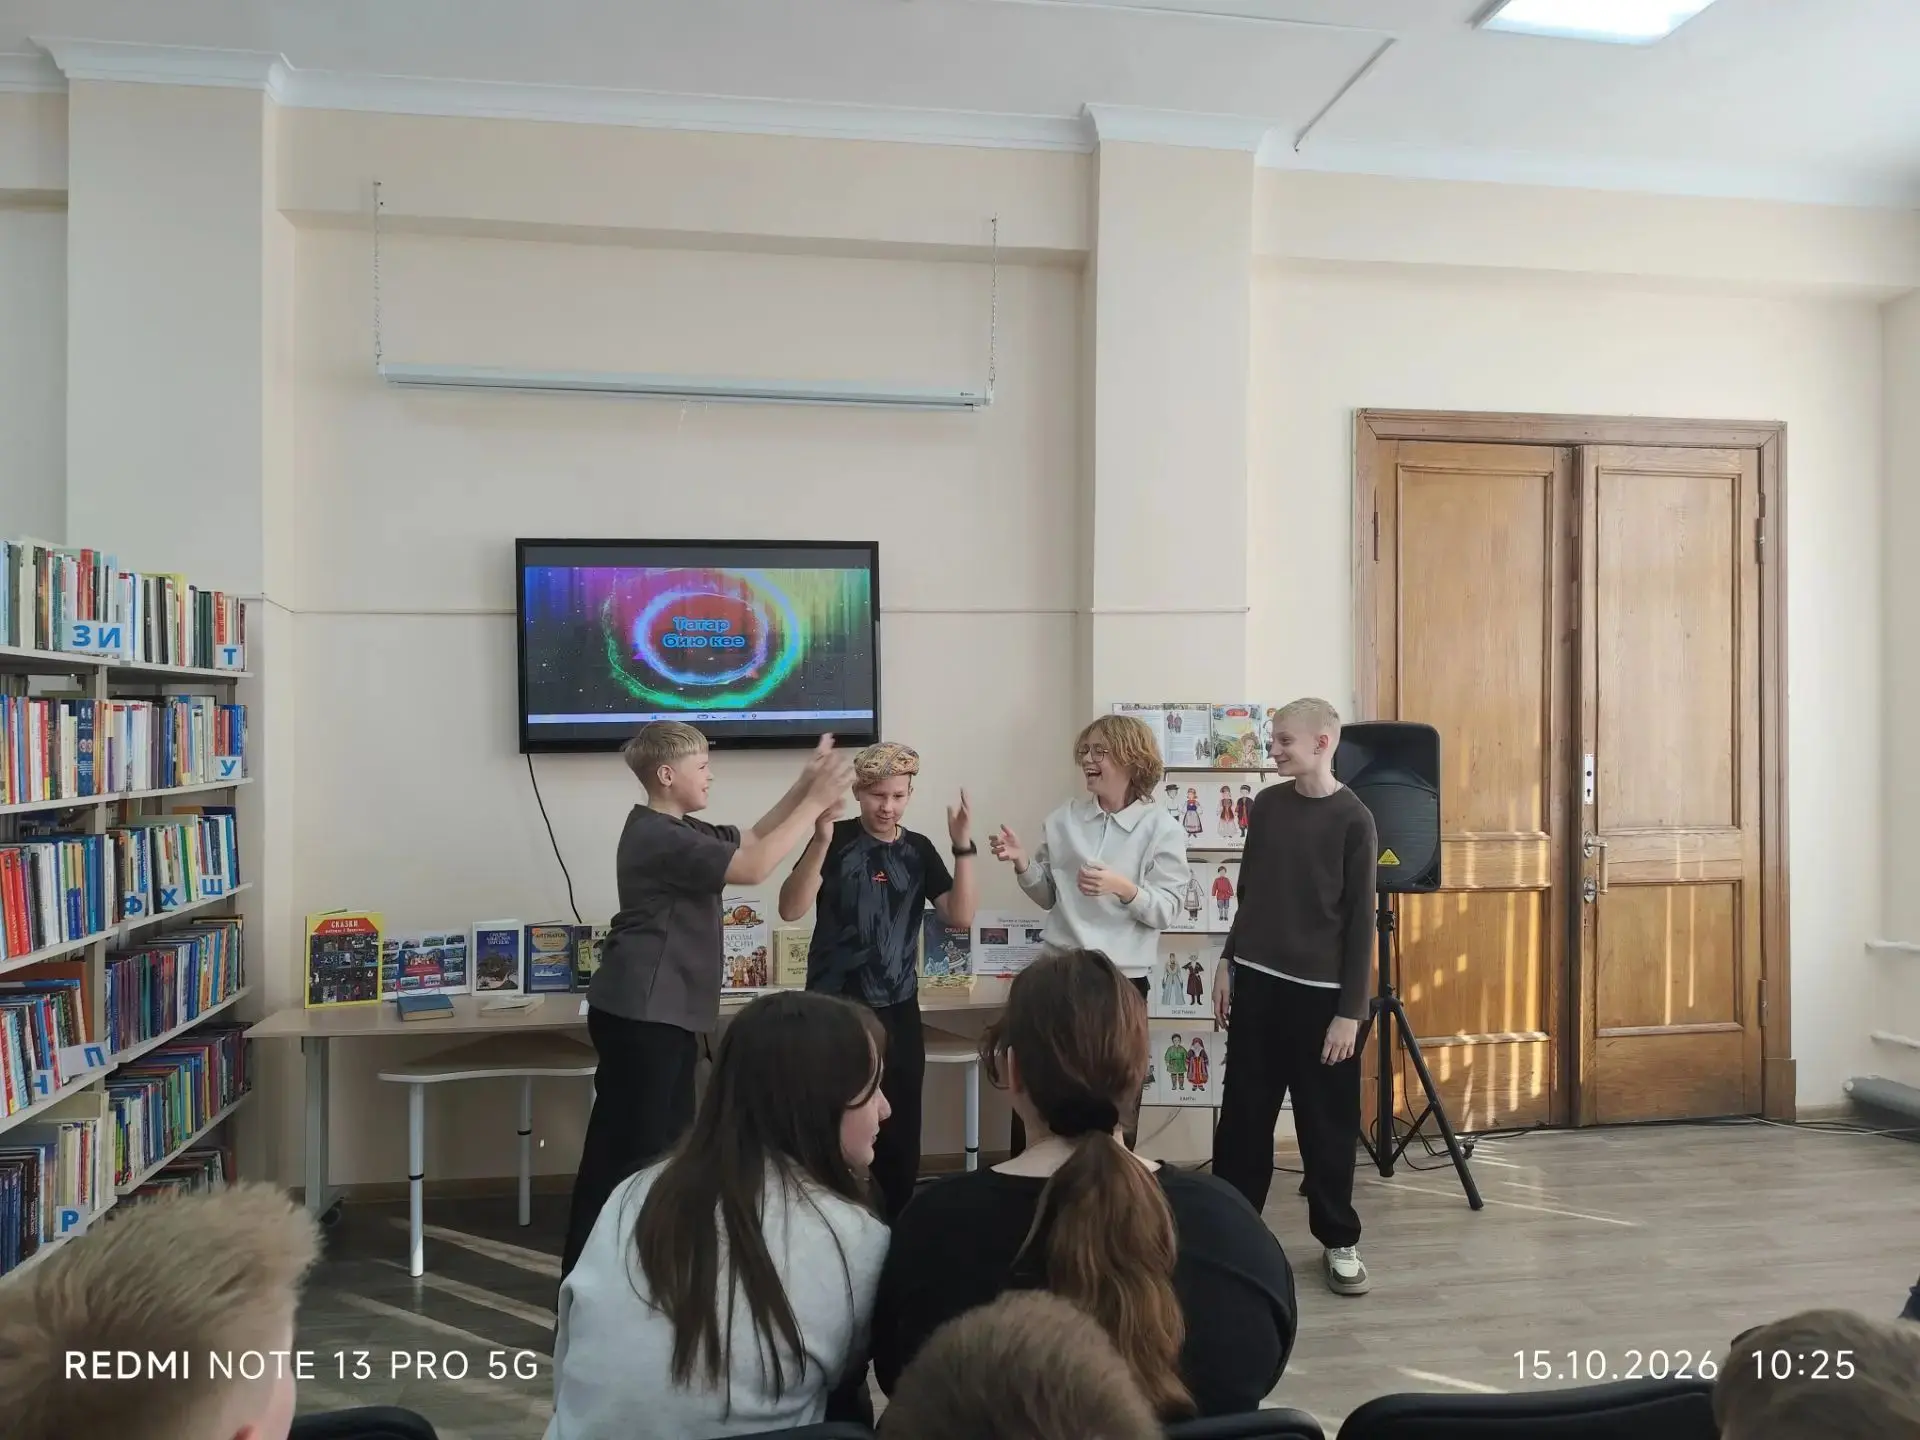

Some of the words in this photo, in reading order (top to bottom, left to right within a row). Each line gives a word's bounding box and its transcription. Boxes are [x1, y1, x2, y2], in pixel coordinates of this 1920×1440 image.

[673, 616, 730, 632] Татар
[663, 633, 707, 648] бию
[223, 648, 237, 665] Т
[221, 760, 236, 776] У
[202, 879, 223, 895] Ш
[160, 888, 178, 906] Х
[124, 896, 143, 915] Ф
[725, 933, 752, 941] АРОДЫ
[84, 1047, 105, 1067] П
[62, 1210, 80, 1233] Р
